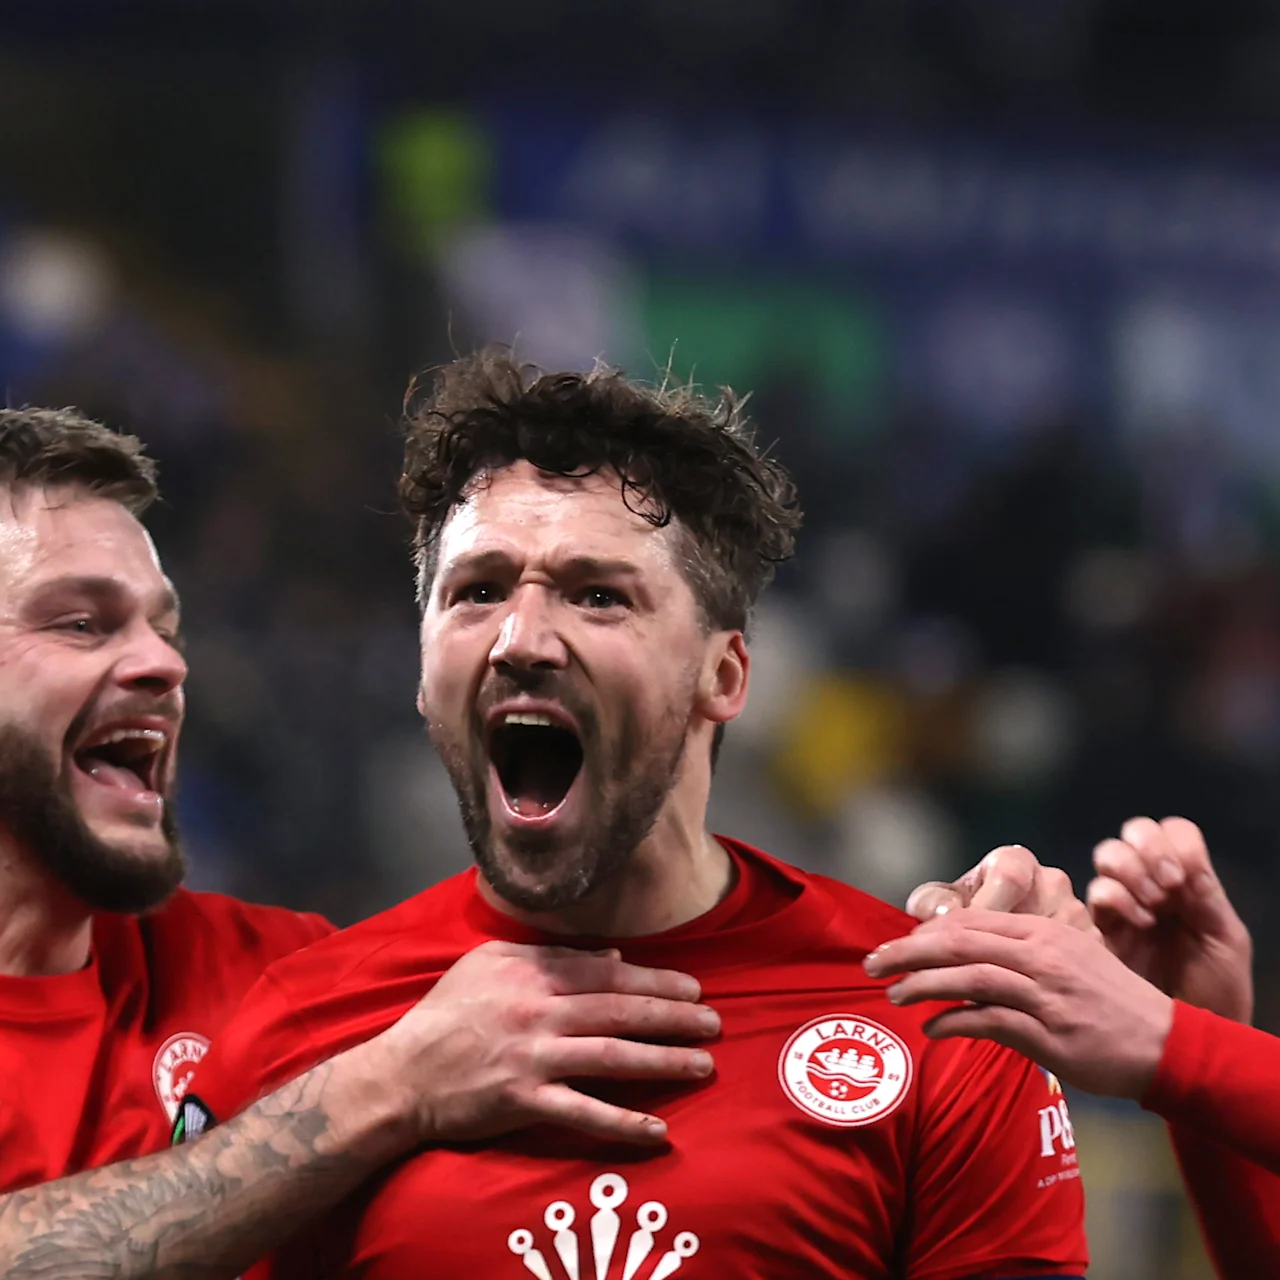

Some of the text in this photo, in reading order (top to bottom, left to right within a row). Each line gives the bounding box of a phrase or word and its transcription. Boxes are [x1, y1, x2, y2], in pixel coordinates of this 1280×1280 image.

[158, 1039, 202, 1070] LARN
[814, 1022, 897, 1055] LARNE
[794, 1080, 881, 1115] FOOTBALL CLUB
[1037, 1098, 1076, 1157] P&
